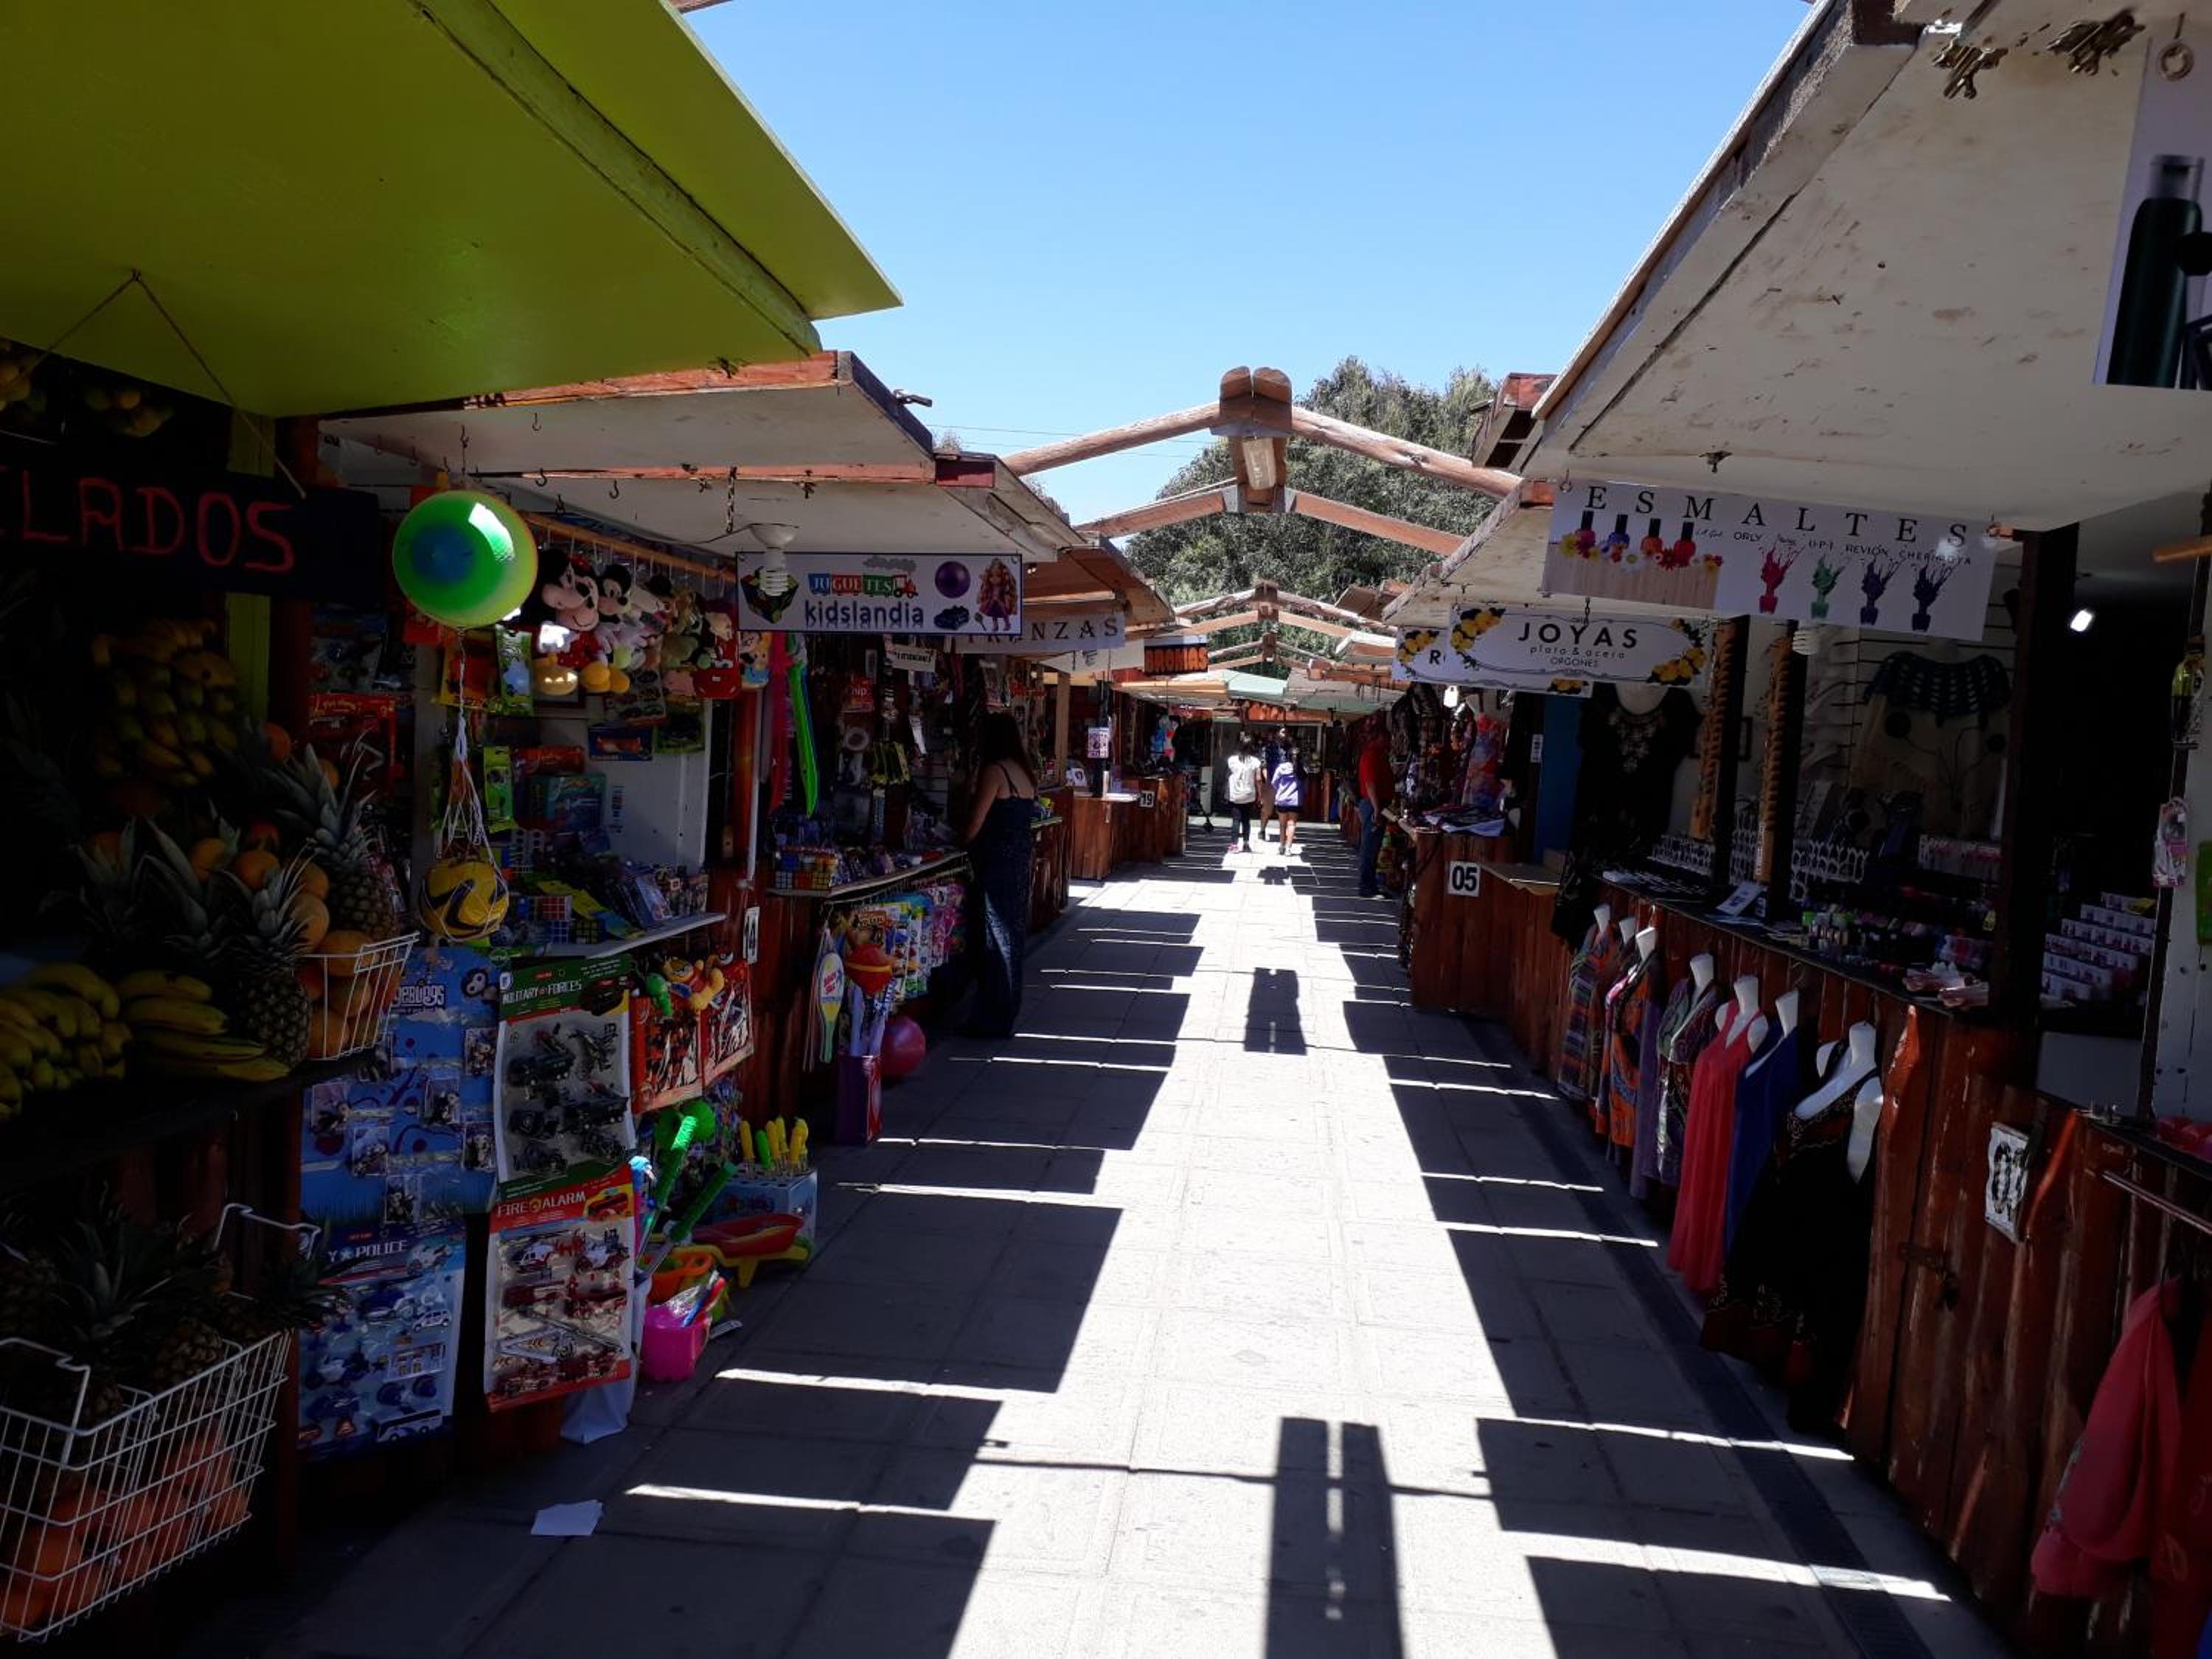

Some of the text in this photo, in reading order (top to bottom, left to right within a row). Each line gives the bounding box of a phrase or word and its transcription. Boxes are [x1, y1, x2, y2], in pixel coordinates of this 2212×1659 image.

[1584, 485, 1967, 547] ESMALTES
[1733, 531, 1763, 542] ORLY
[804, 599, 925, 625] kidslandia
[1517, 622, 1638, 648] JOYAS
[1571, 647, 1580, 655] &
[1143, 793, 1153, 806] 19
[1451, 865, 1478, 891] 05
[548, 978, 582, 995] FORCES
[497, 1200, 529, 1217] FIRE
[541, 1190, 587, 1210] ALARM
[354, 1239, 408, 1259] POLICE
